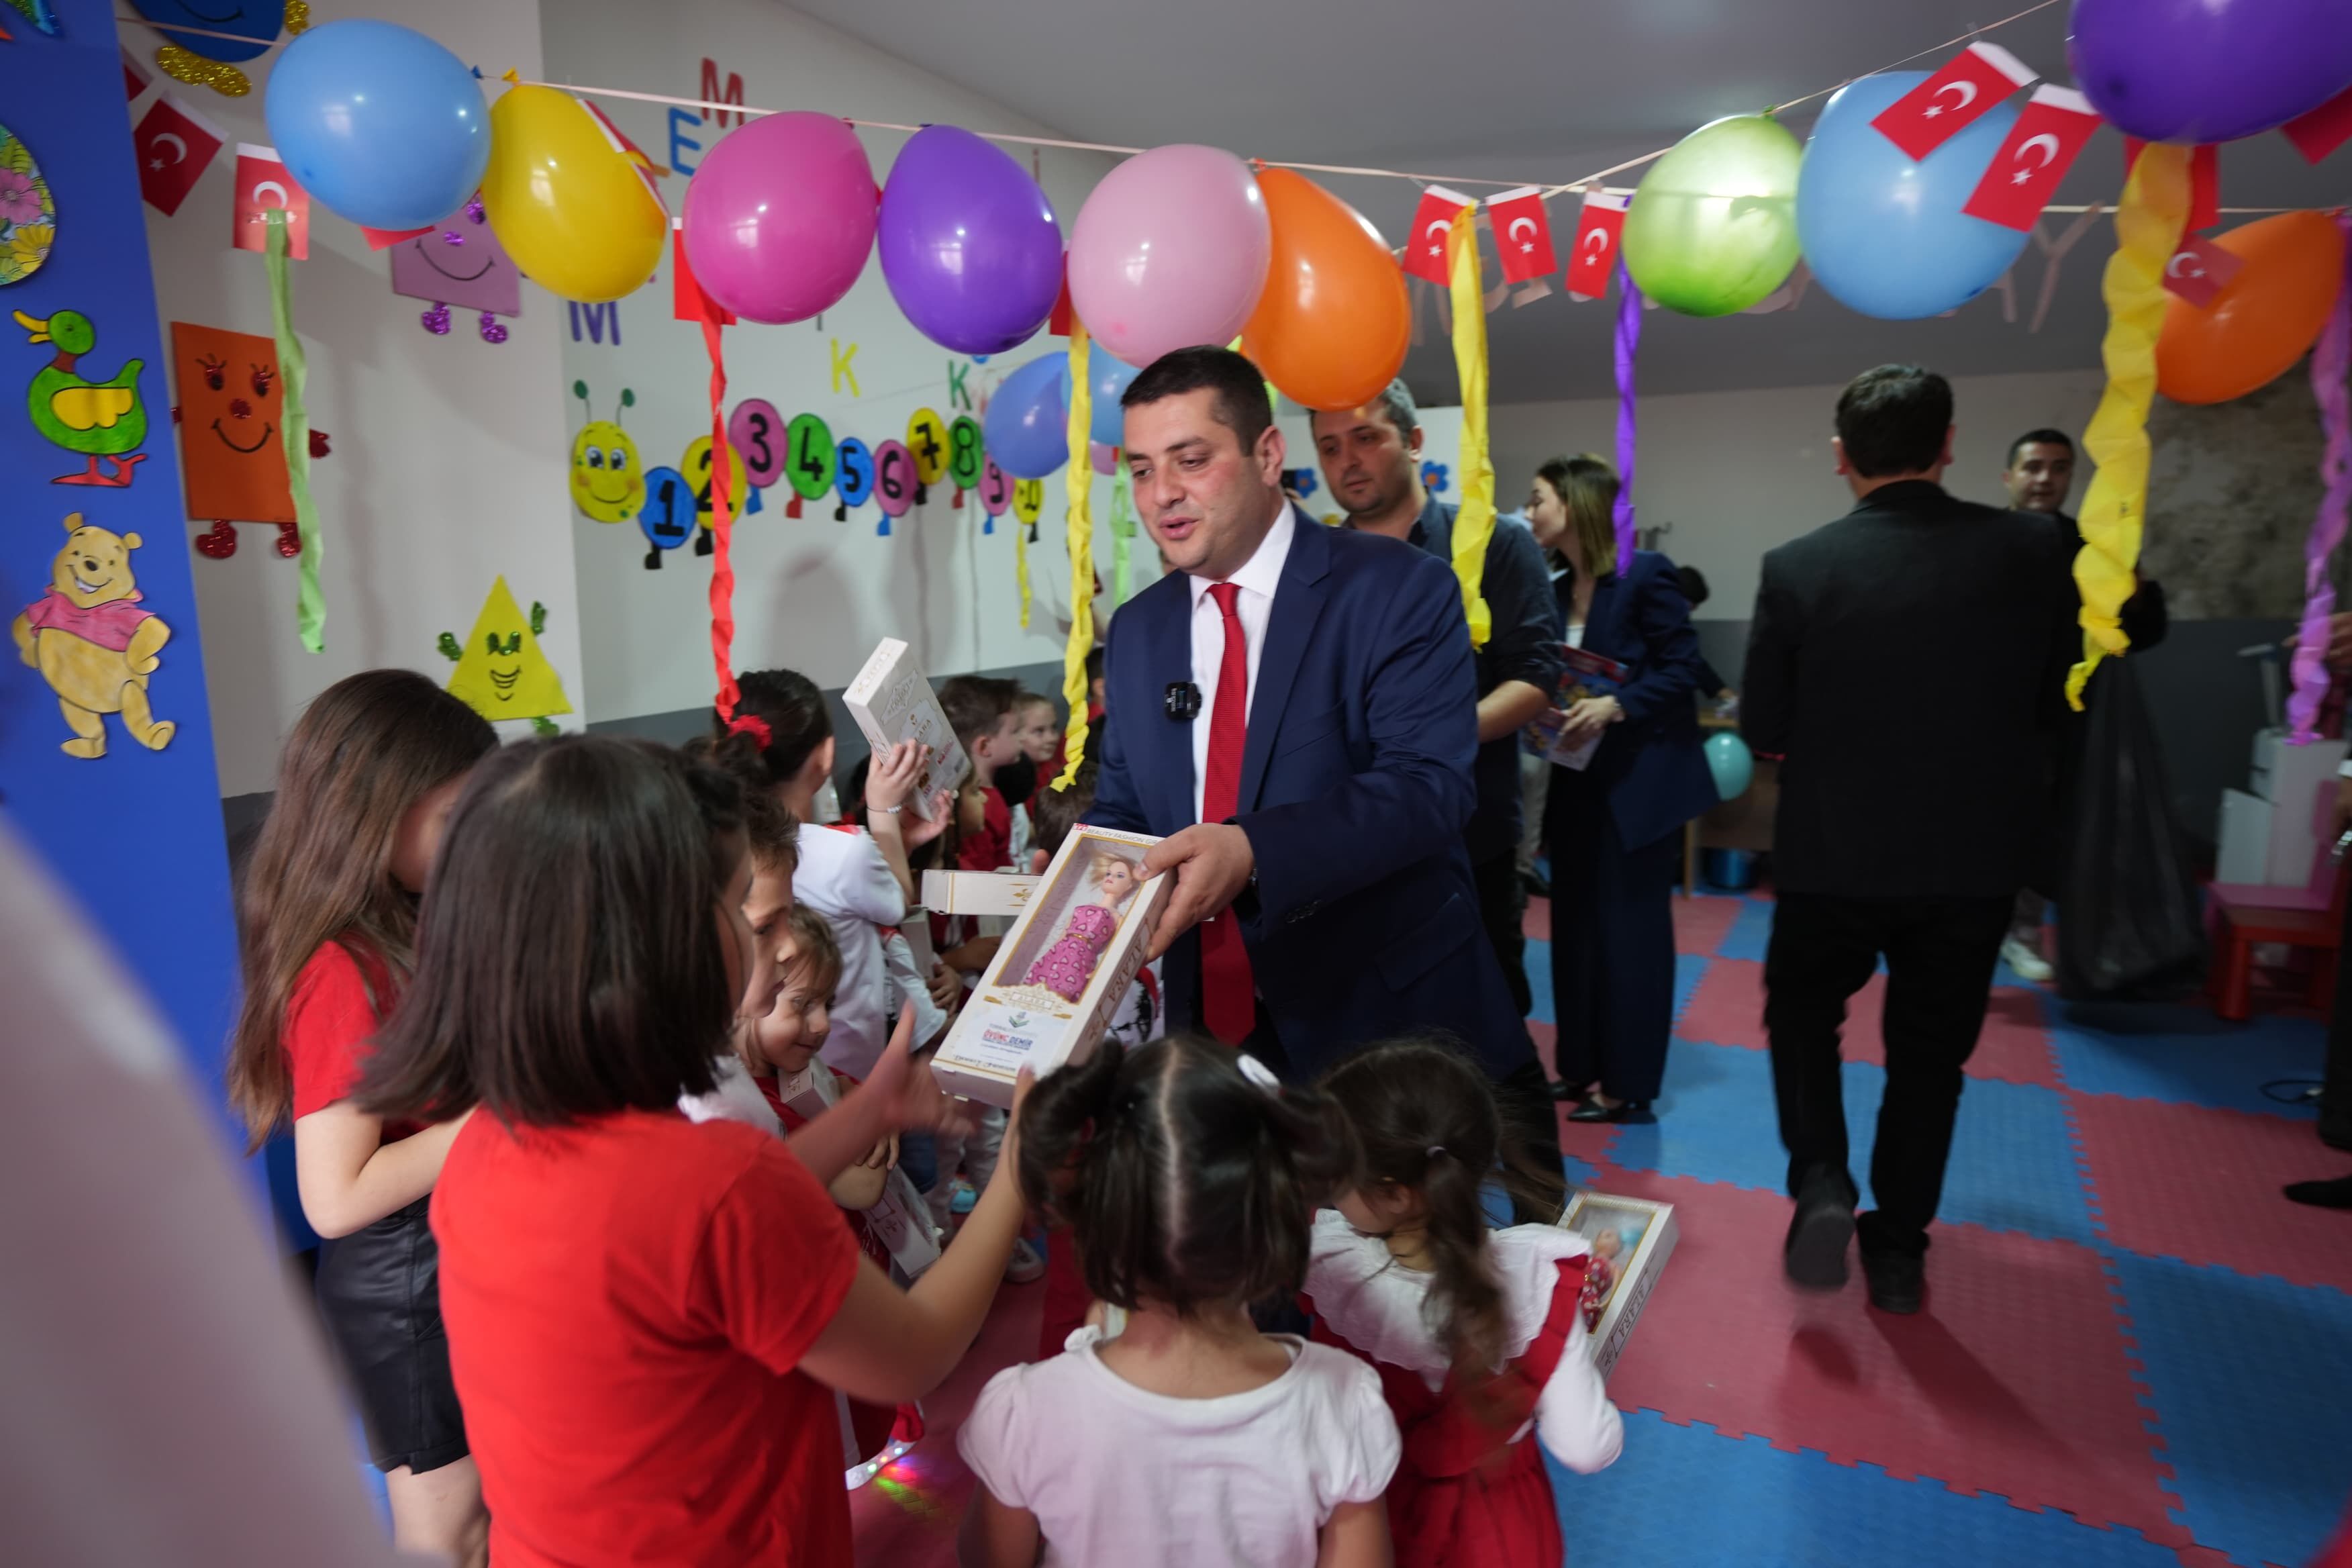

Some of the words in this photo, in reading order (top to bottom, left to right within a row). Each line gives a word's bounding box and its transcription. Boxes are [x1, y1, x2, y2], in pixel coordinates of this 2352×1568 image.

[830, 337, 861, 399] K
[948, 359, 973, 411] K
[654, 479, 685, 537] 1
[749, 412, 772, 473] 3
[798, 425, 825, 482] 4
[841, 446, 861, 493] 5
[881, 450, 902, 500] 6
[916, 421, 940, 472] 7
[955, 422, 977, 477] 8
[989, 461, 1005, 504] 9
[1087, 828, 1114, 838] BEAUTY
[1114, 832, 1144, 843] FASHION
